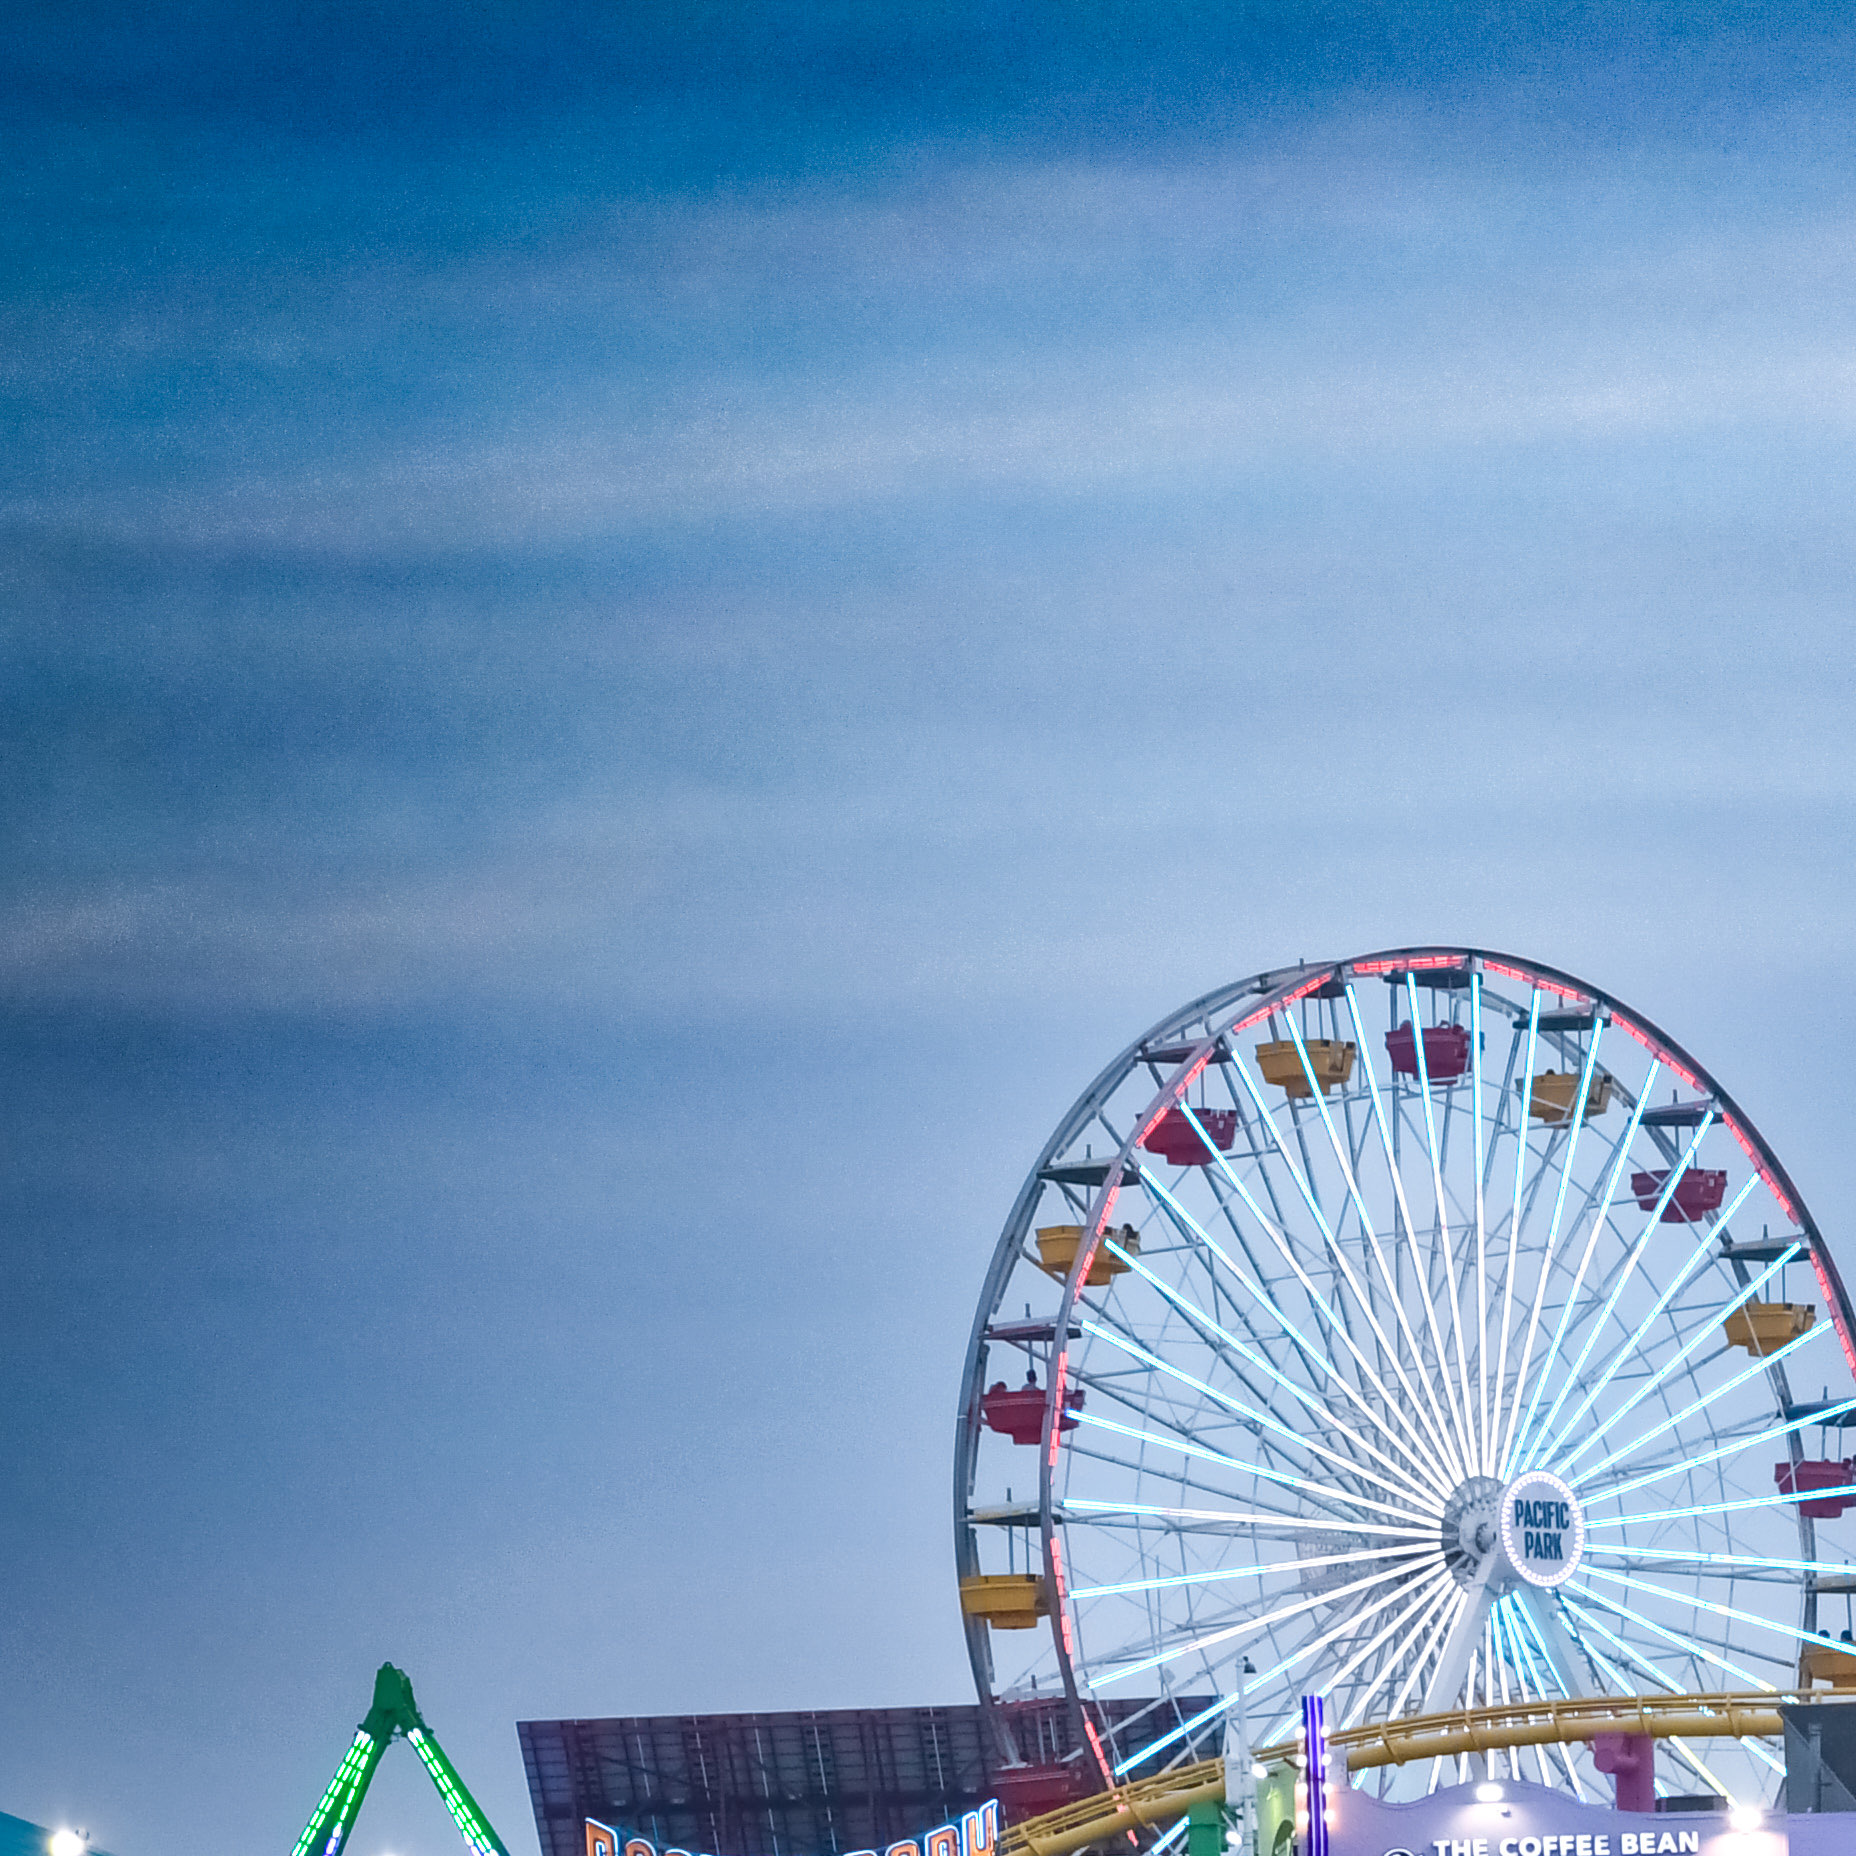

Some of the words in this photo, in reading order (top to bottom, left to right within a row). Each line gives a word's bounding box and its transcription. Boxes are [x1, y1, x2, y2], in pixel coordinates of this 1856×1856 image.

[1515, 1500, 1569, 1529] PACIFIC
[1524, 1531, 1563, 1560] PARK
[1620, 1831, 1699, 1856] BEAN
